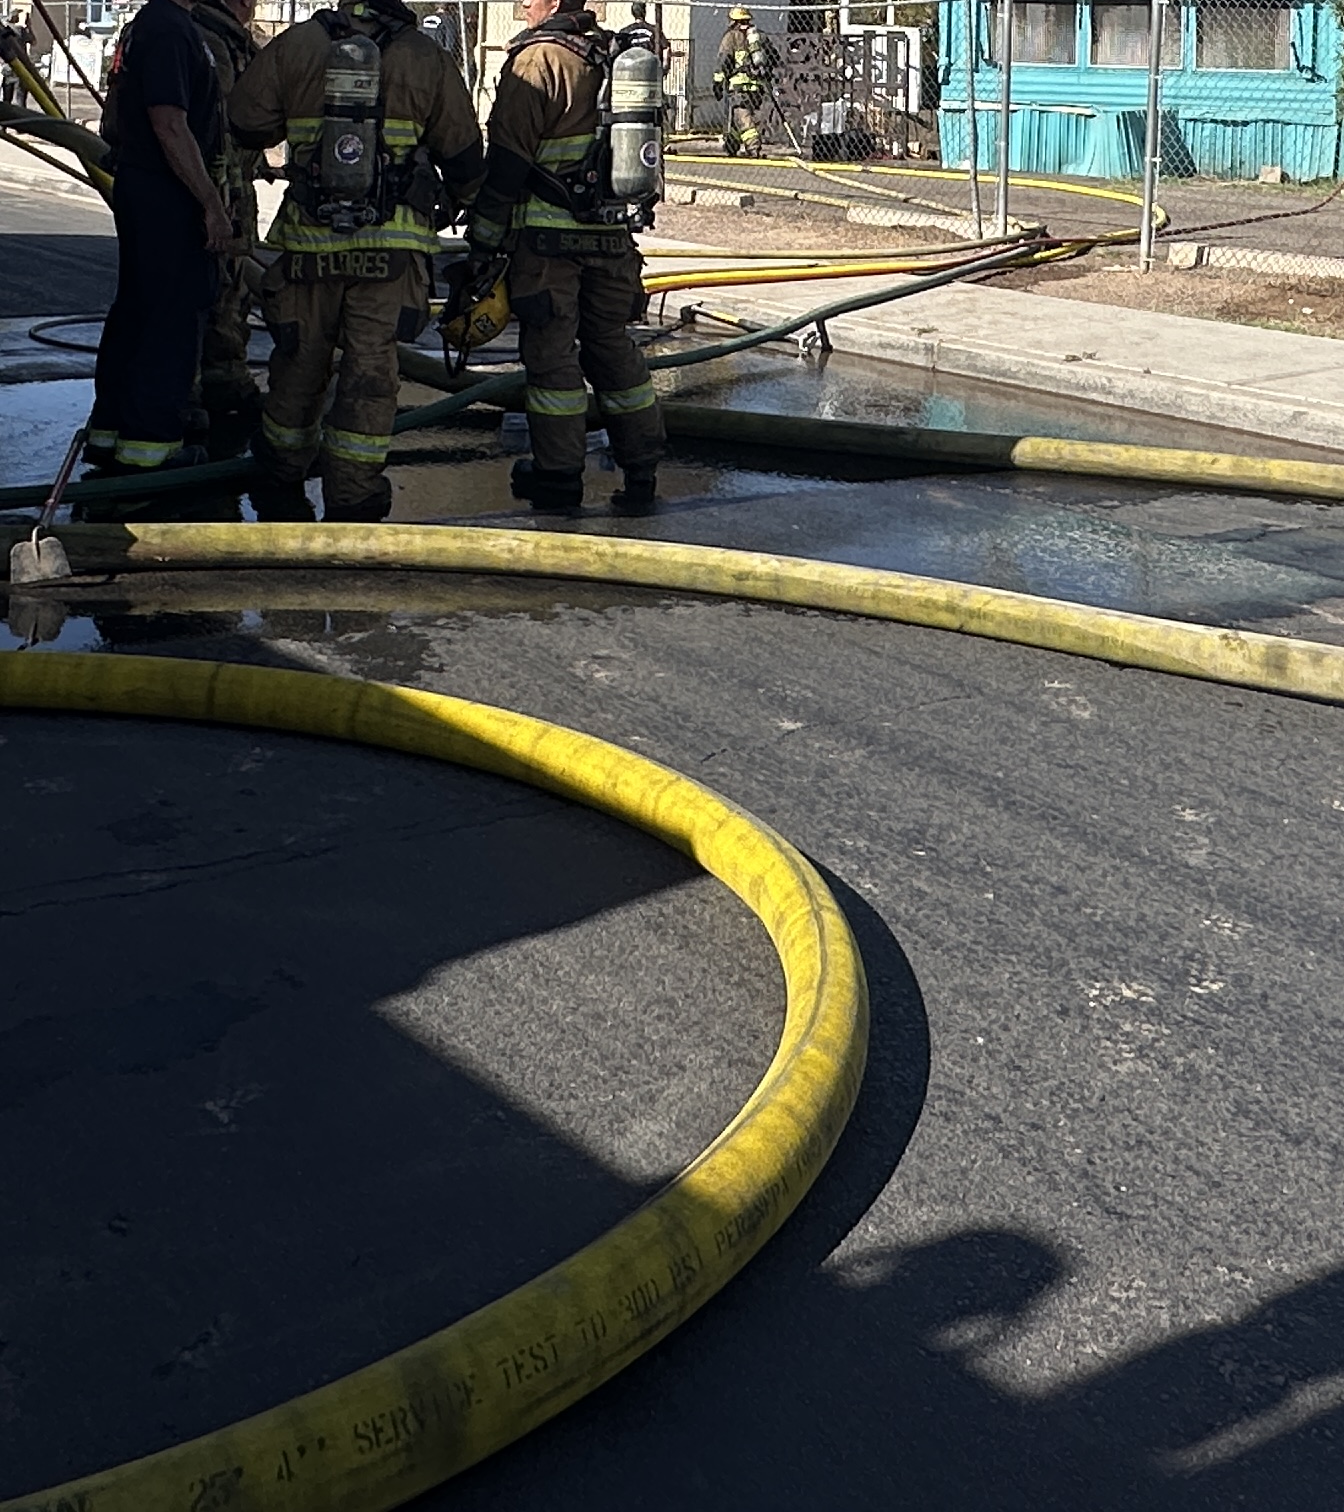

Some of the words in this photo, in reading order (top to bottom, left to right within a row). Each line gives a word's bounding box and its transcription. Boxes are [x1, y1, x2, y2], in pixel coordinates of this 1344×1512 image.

[315, 251, 391, 280] FLORES
[352, 1373, 484, 1455] SERVICE
[496, 1333, 560, 1390] TEST
[574, 1311, 608, 1345] TO
